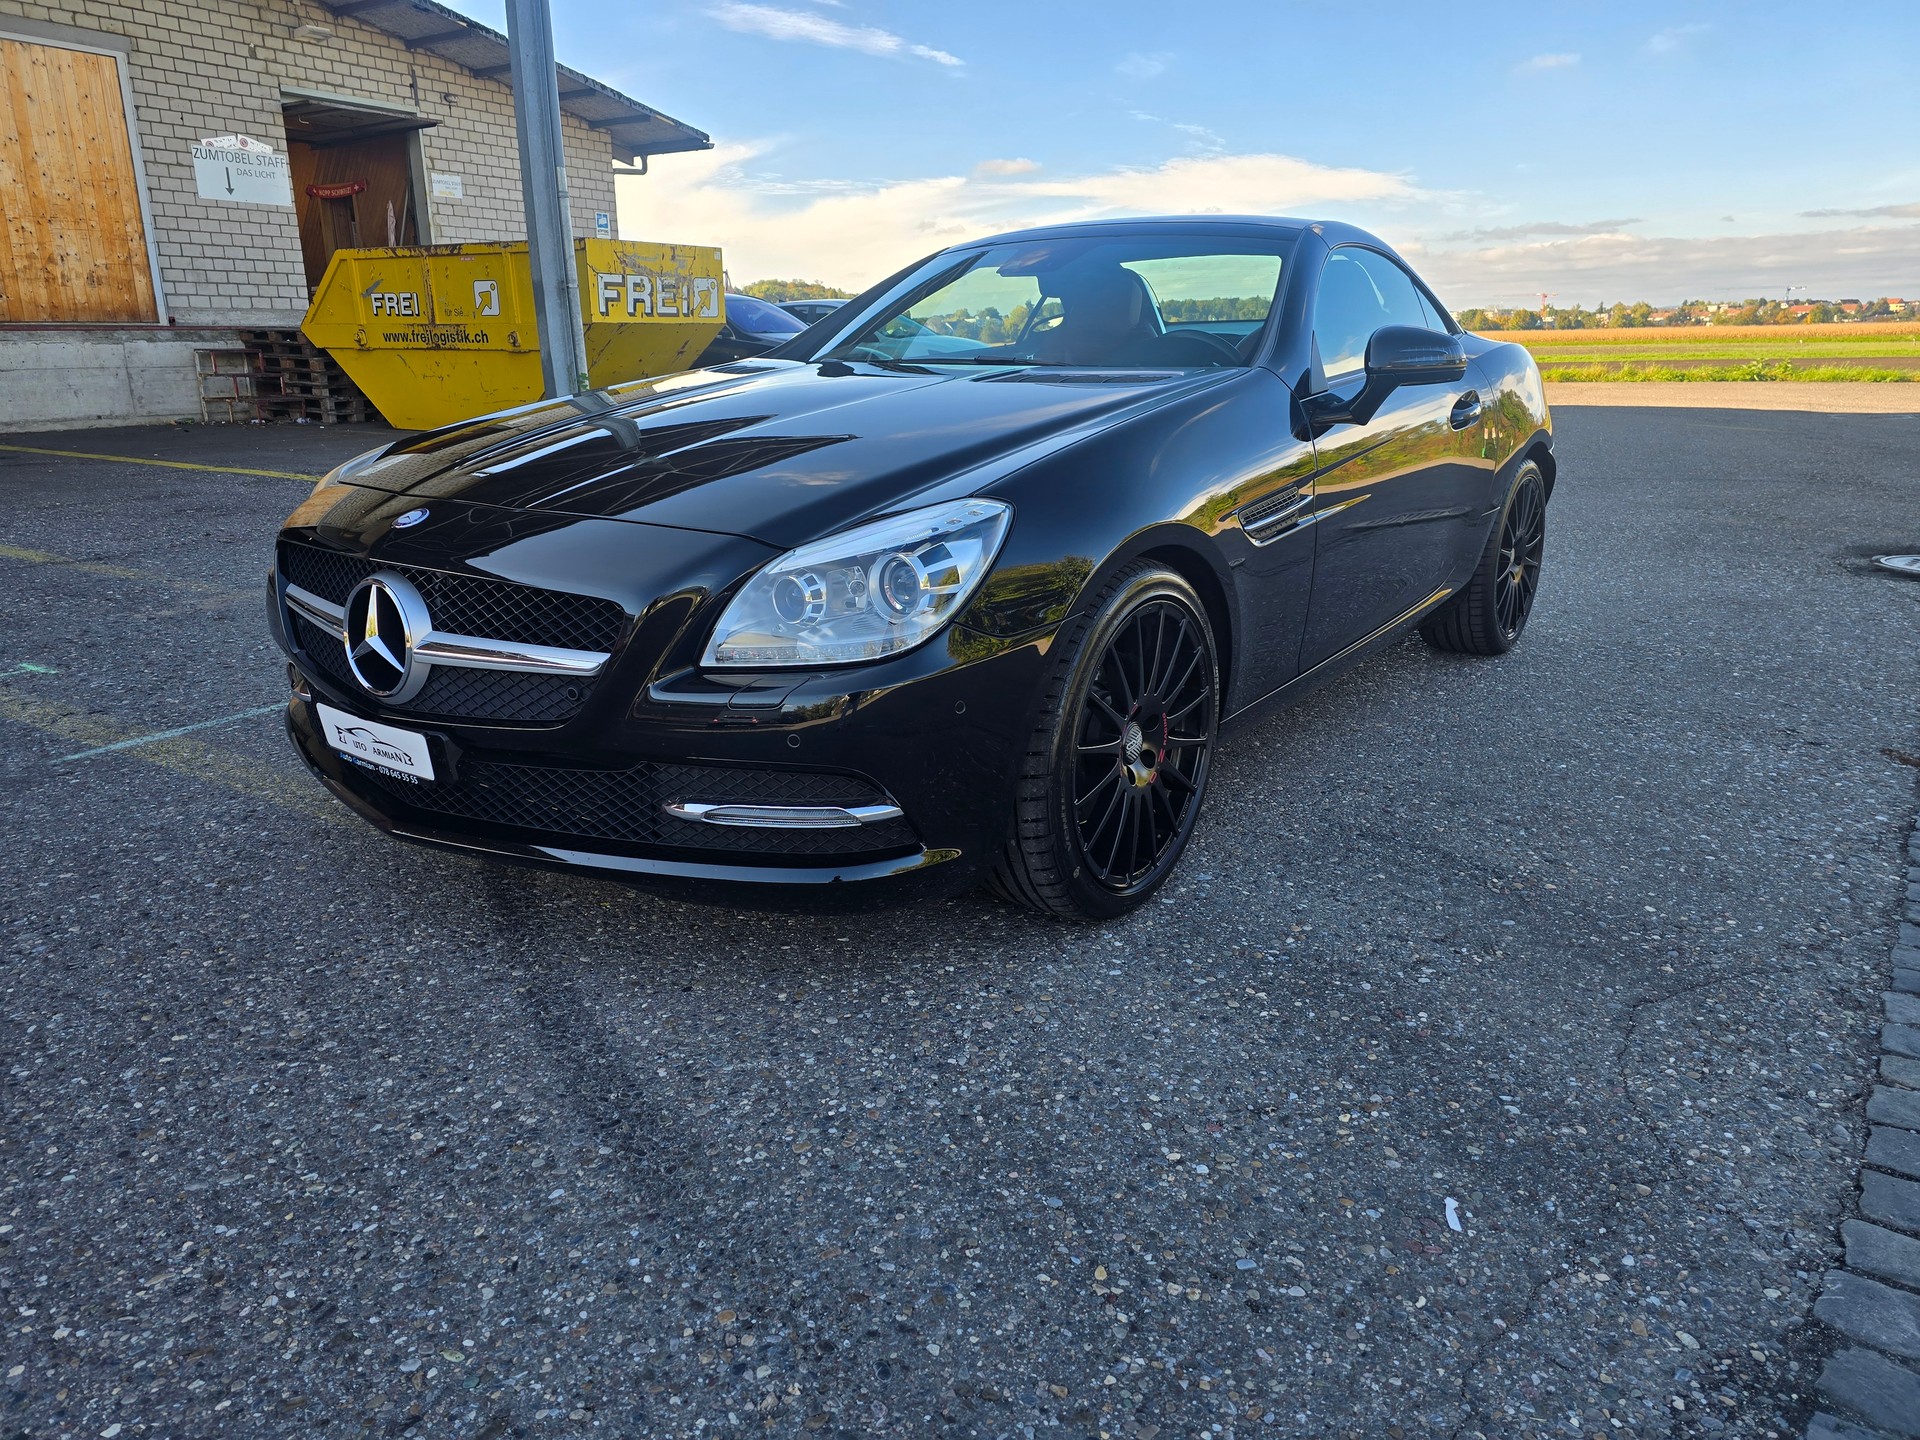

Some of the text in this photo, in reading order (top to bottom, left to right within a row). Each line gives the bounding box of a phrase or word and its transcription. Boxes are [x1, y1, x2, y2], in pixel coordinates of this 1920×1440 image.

[192, 147, 253, 166] ZUMTOBEL
[256, 154, 286, 169] STAFF
[236, 168, 276, 180] DAS LICHT
[371, 292, 421, 317] FREI
[597, 273, 691, 318] FREI
[382, 329, 489, 345] www.freilogistik.ch
[379, 766, 389, 776] 078
